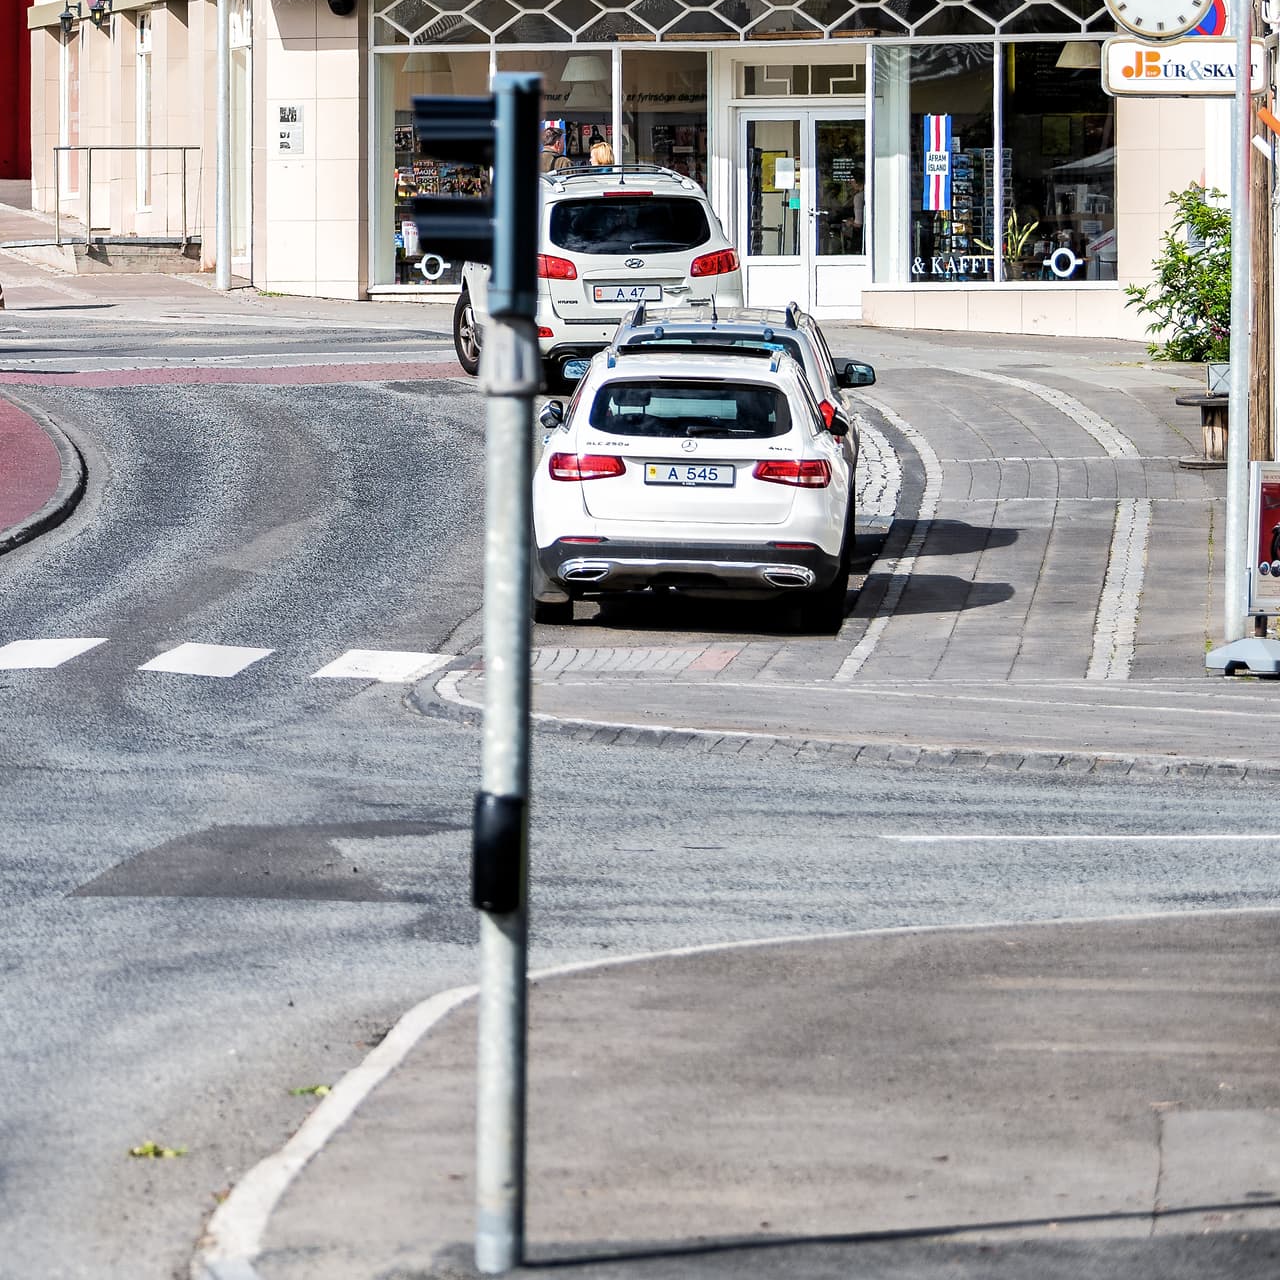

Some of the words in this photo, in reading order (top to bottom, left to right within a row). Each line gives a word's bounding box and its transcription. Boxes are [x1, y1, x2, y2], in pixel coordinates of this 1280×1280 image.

[927, 153, 947, 163] ÁFRAM
[927, 163, 947, 172] ÍSLAND
[911, 257, 926, 274] &
[616, 288, 625, 298] A
[630, 287, 646, 299] 47
[667, 469, 679, 481] A
[686, 467, 719, 481] 545
